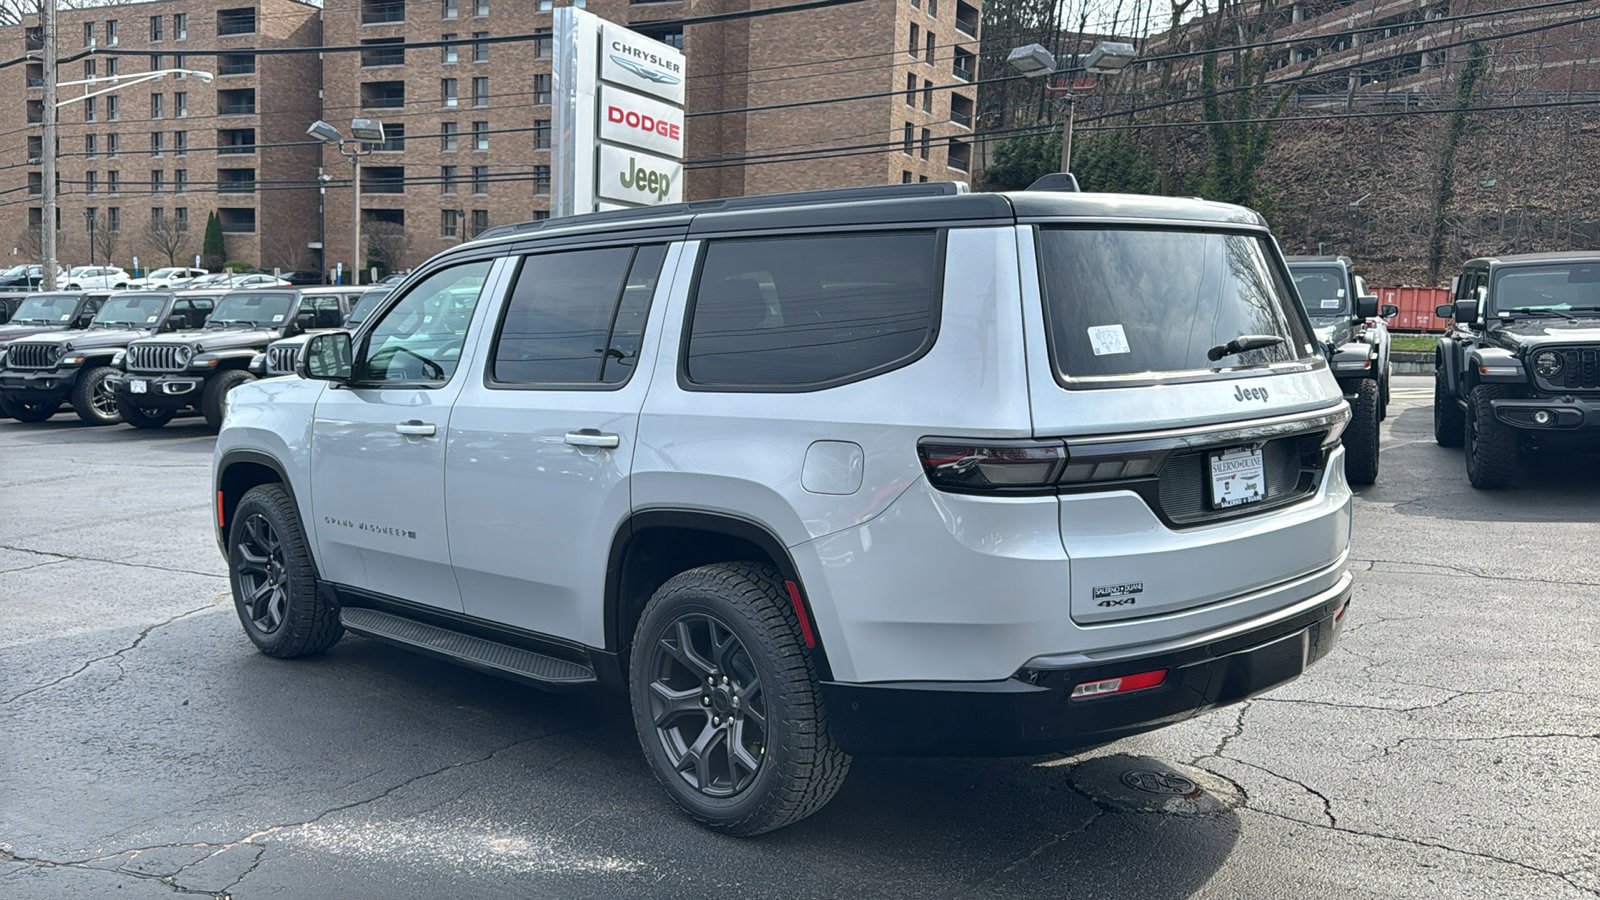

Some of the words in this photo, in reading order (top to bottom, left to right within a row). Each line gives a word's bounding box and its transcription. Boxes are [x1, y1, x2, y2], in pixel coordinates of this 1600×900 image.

[611, 41, 680, 73] CHRYSLER
[608, 105, 680, 141] DODGE
[620, 157, 670, 201] Jeep
[1234, 385, 1269, 402] Jeep
[1212, 460, 1240, 473] SALERNO
[1244, 482, 1258, 491] Jeep
[324, 516, 354, 528] GRAND
[359, 522, 407, 537] WAGONEER
